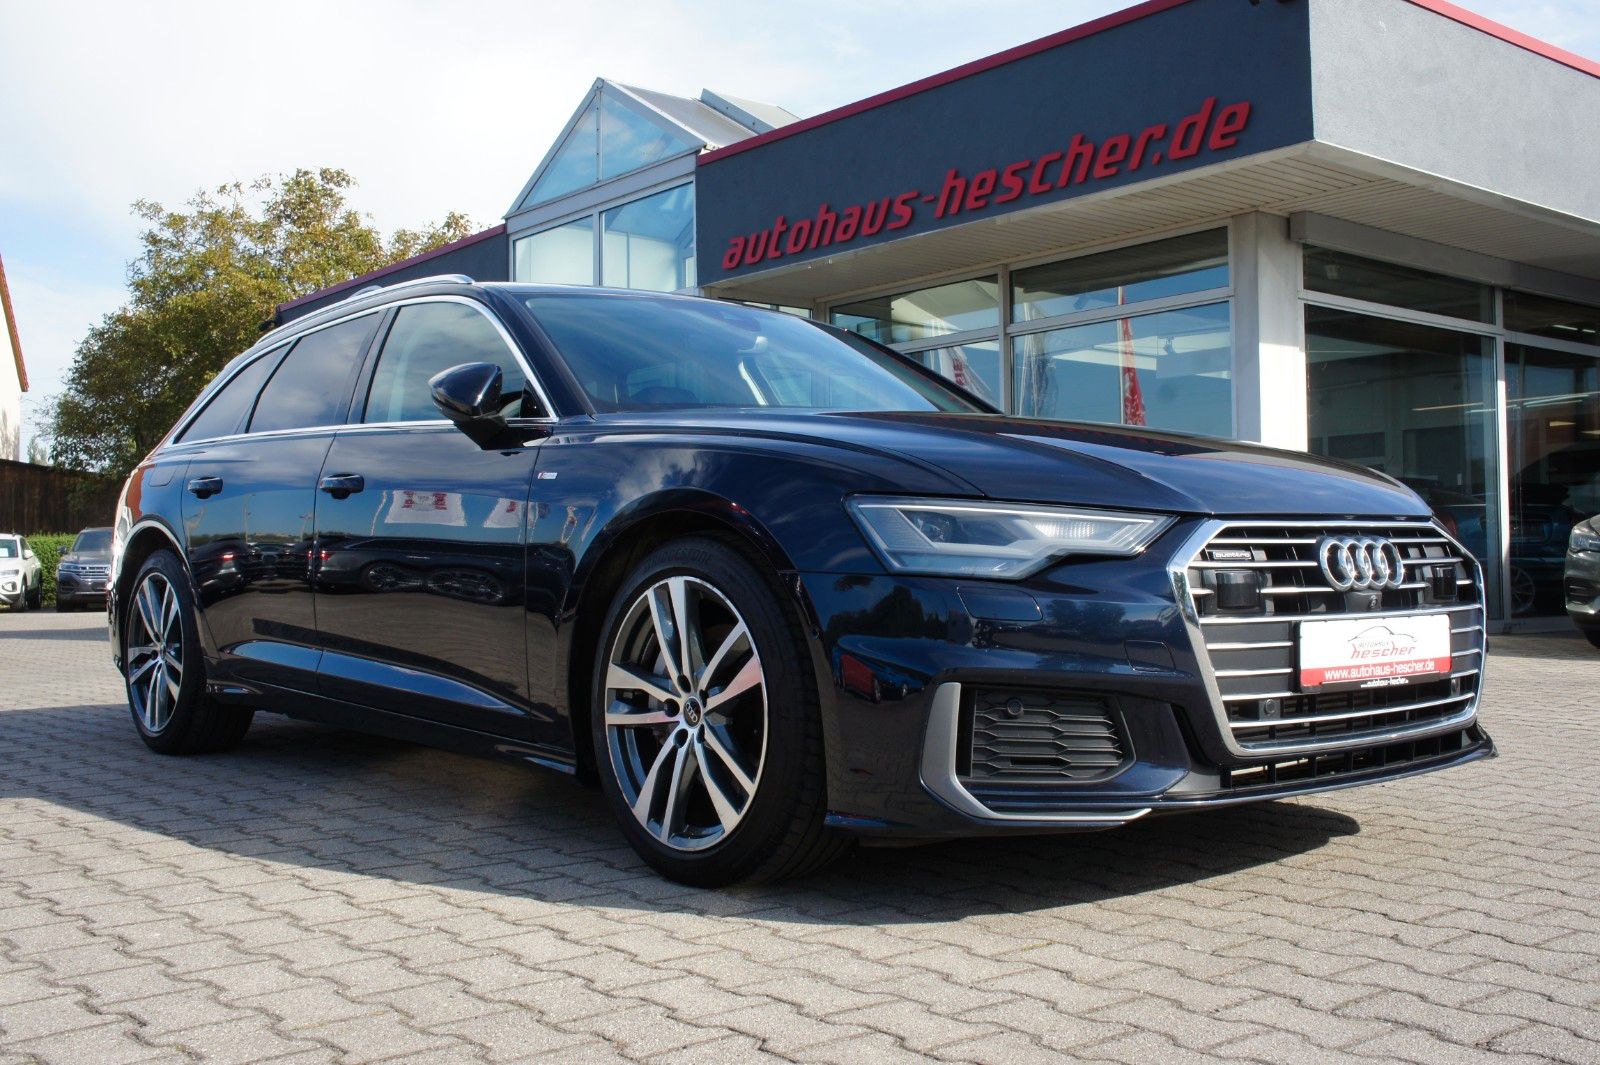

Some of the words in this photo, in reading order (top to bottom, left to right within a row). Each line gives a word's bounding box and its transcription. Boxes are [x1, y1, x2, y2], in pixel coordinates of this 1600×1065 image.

[722, 98, 1251, 270] autohaus-hescher.de
[1350, 641, 1416, 659] hescher
[1324, 660, 1435, 680] www.autohaus-hescher.de
